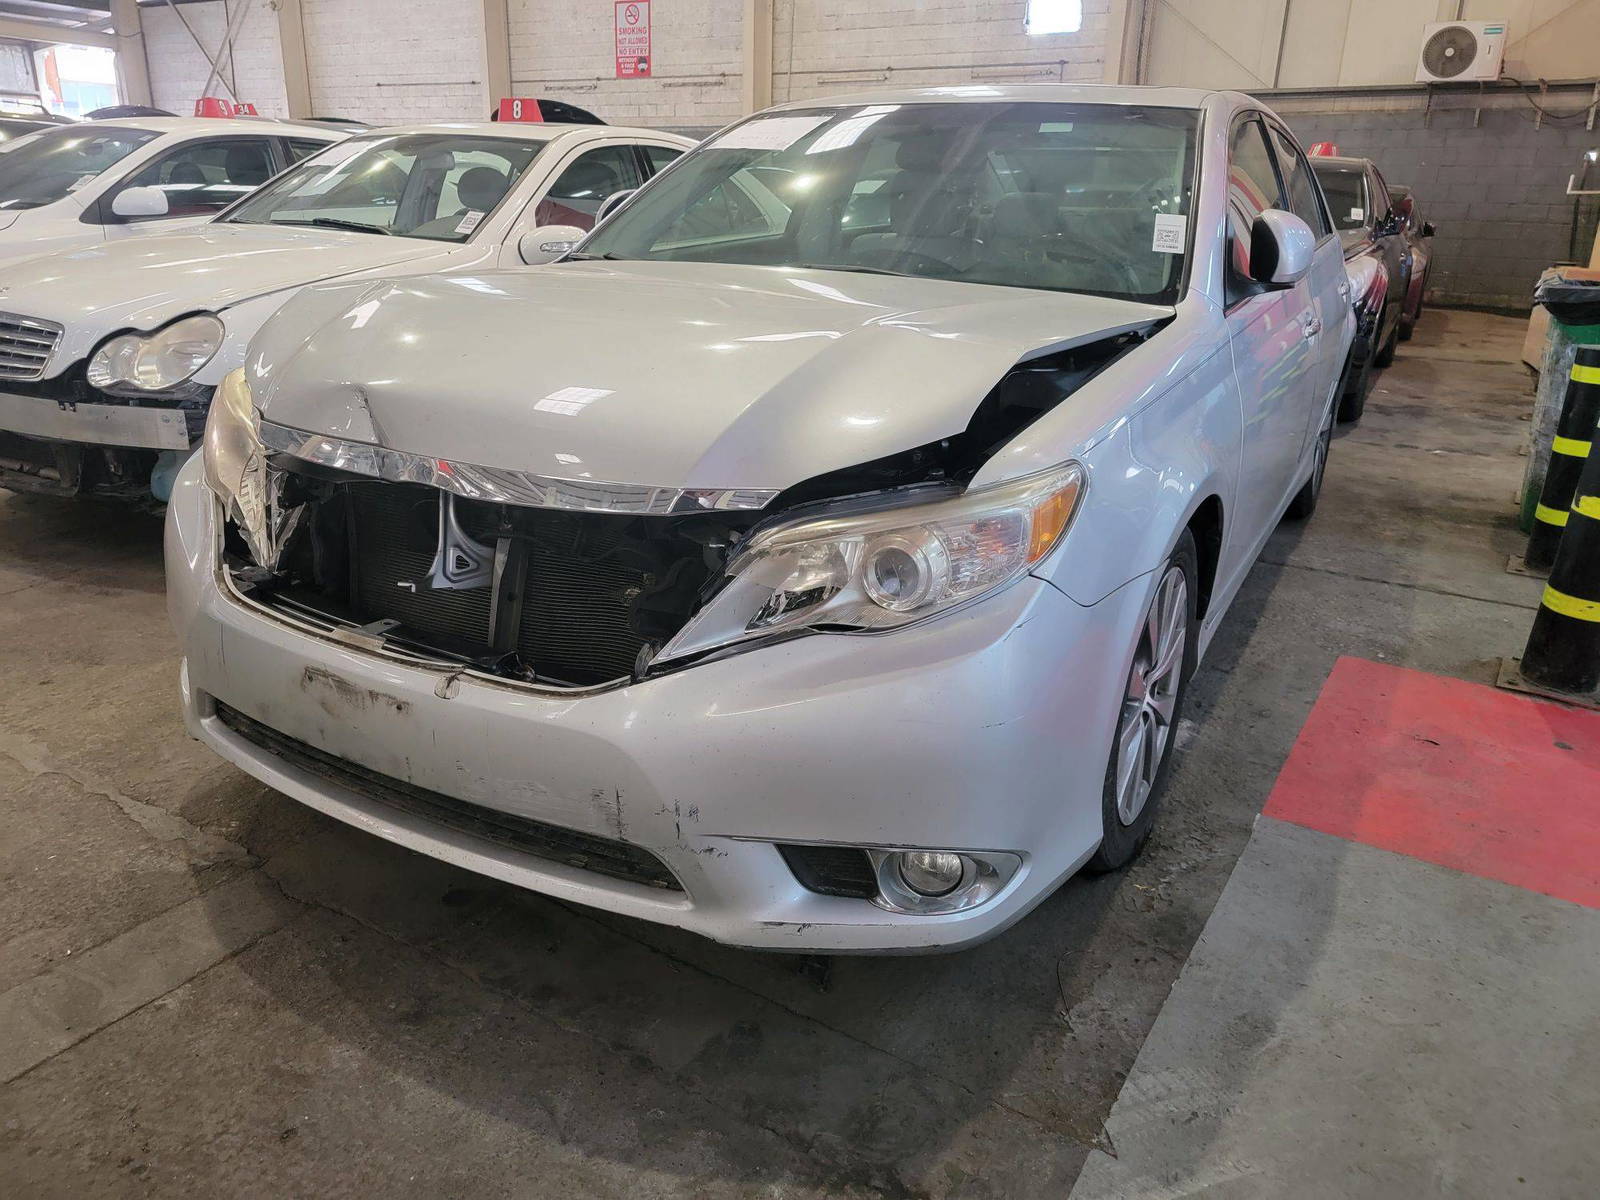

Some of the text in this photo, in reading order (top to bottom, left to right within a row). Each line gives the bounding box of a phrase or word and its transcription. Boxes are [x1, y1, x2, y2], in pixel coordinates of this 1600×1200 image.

[618, 27, 647, 35] SMOKING
[629, 47, 648, 55] ENTRY
[219, 100, 228, 116] 9
[238, 104, 250, 114] 34
[513, 100, 522, 119] 8
